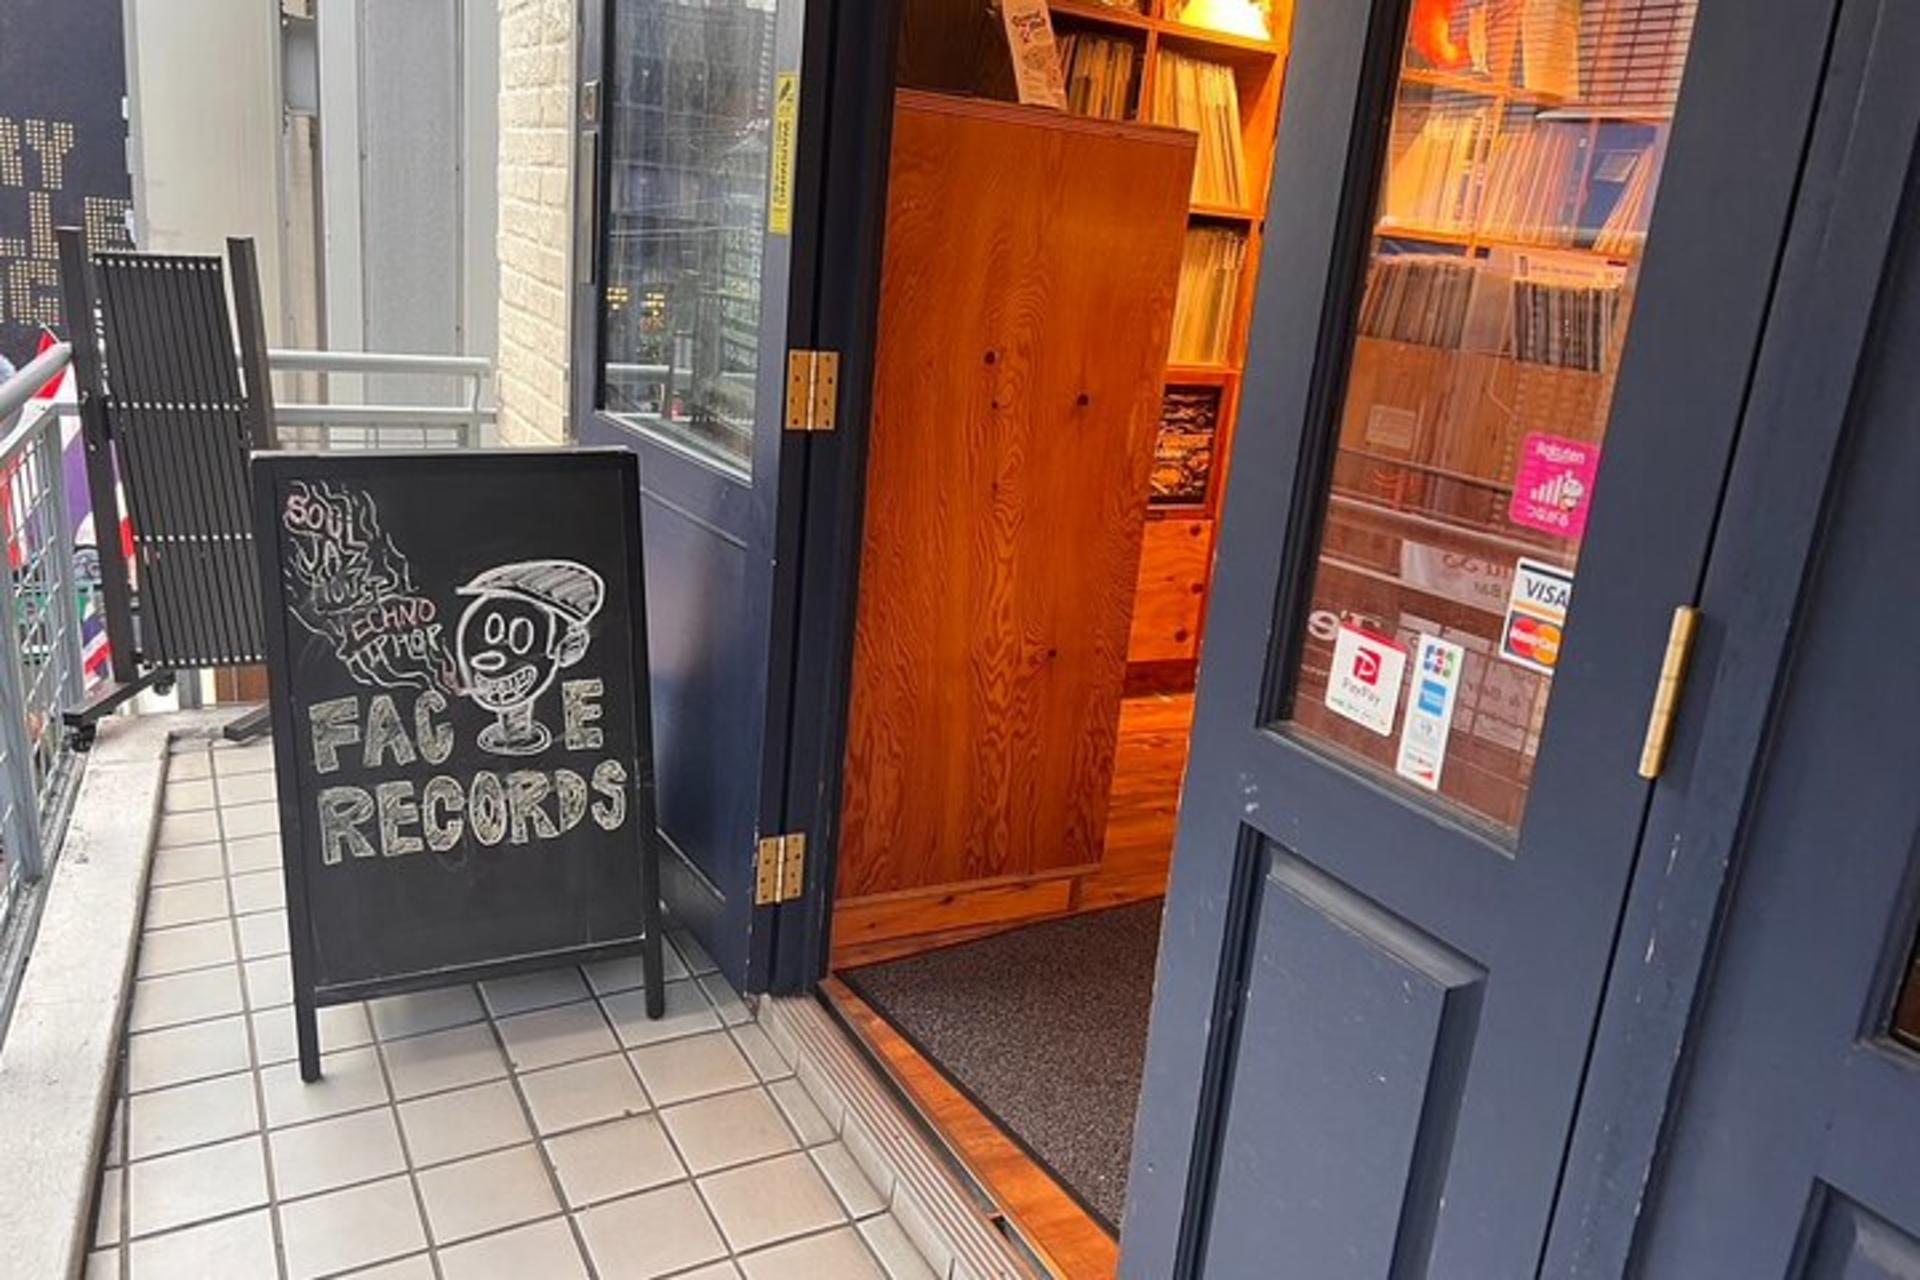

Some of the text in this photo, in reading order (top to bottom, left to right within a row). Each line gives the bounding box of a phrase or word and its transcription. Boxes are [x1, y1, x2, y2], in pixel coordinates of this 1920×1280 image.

[285, 494, 369, 549] SOUL
[1526, 577, 1570, 607] VISA
[316, 759, 628, 866] RECORDS
